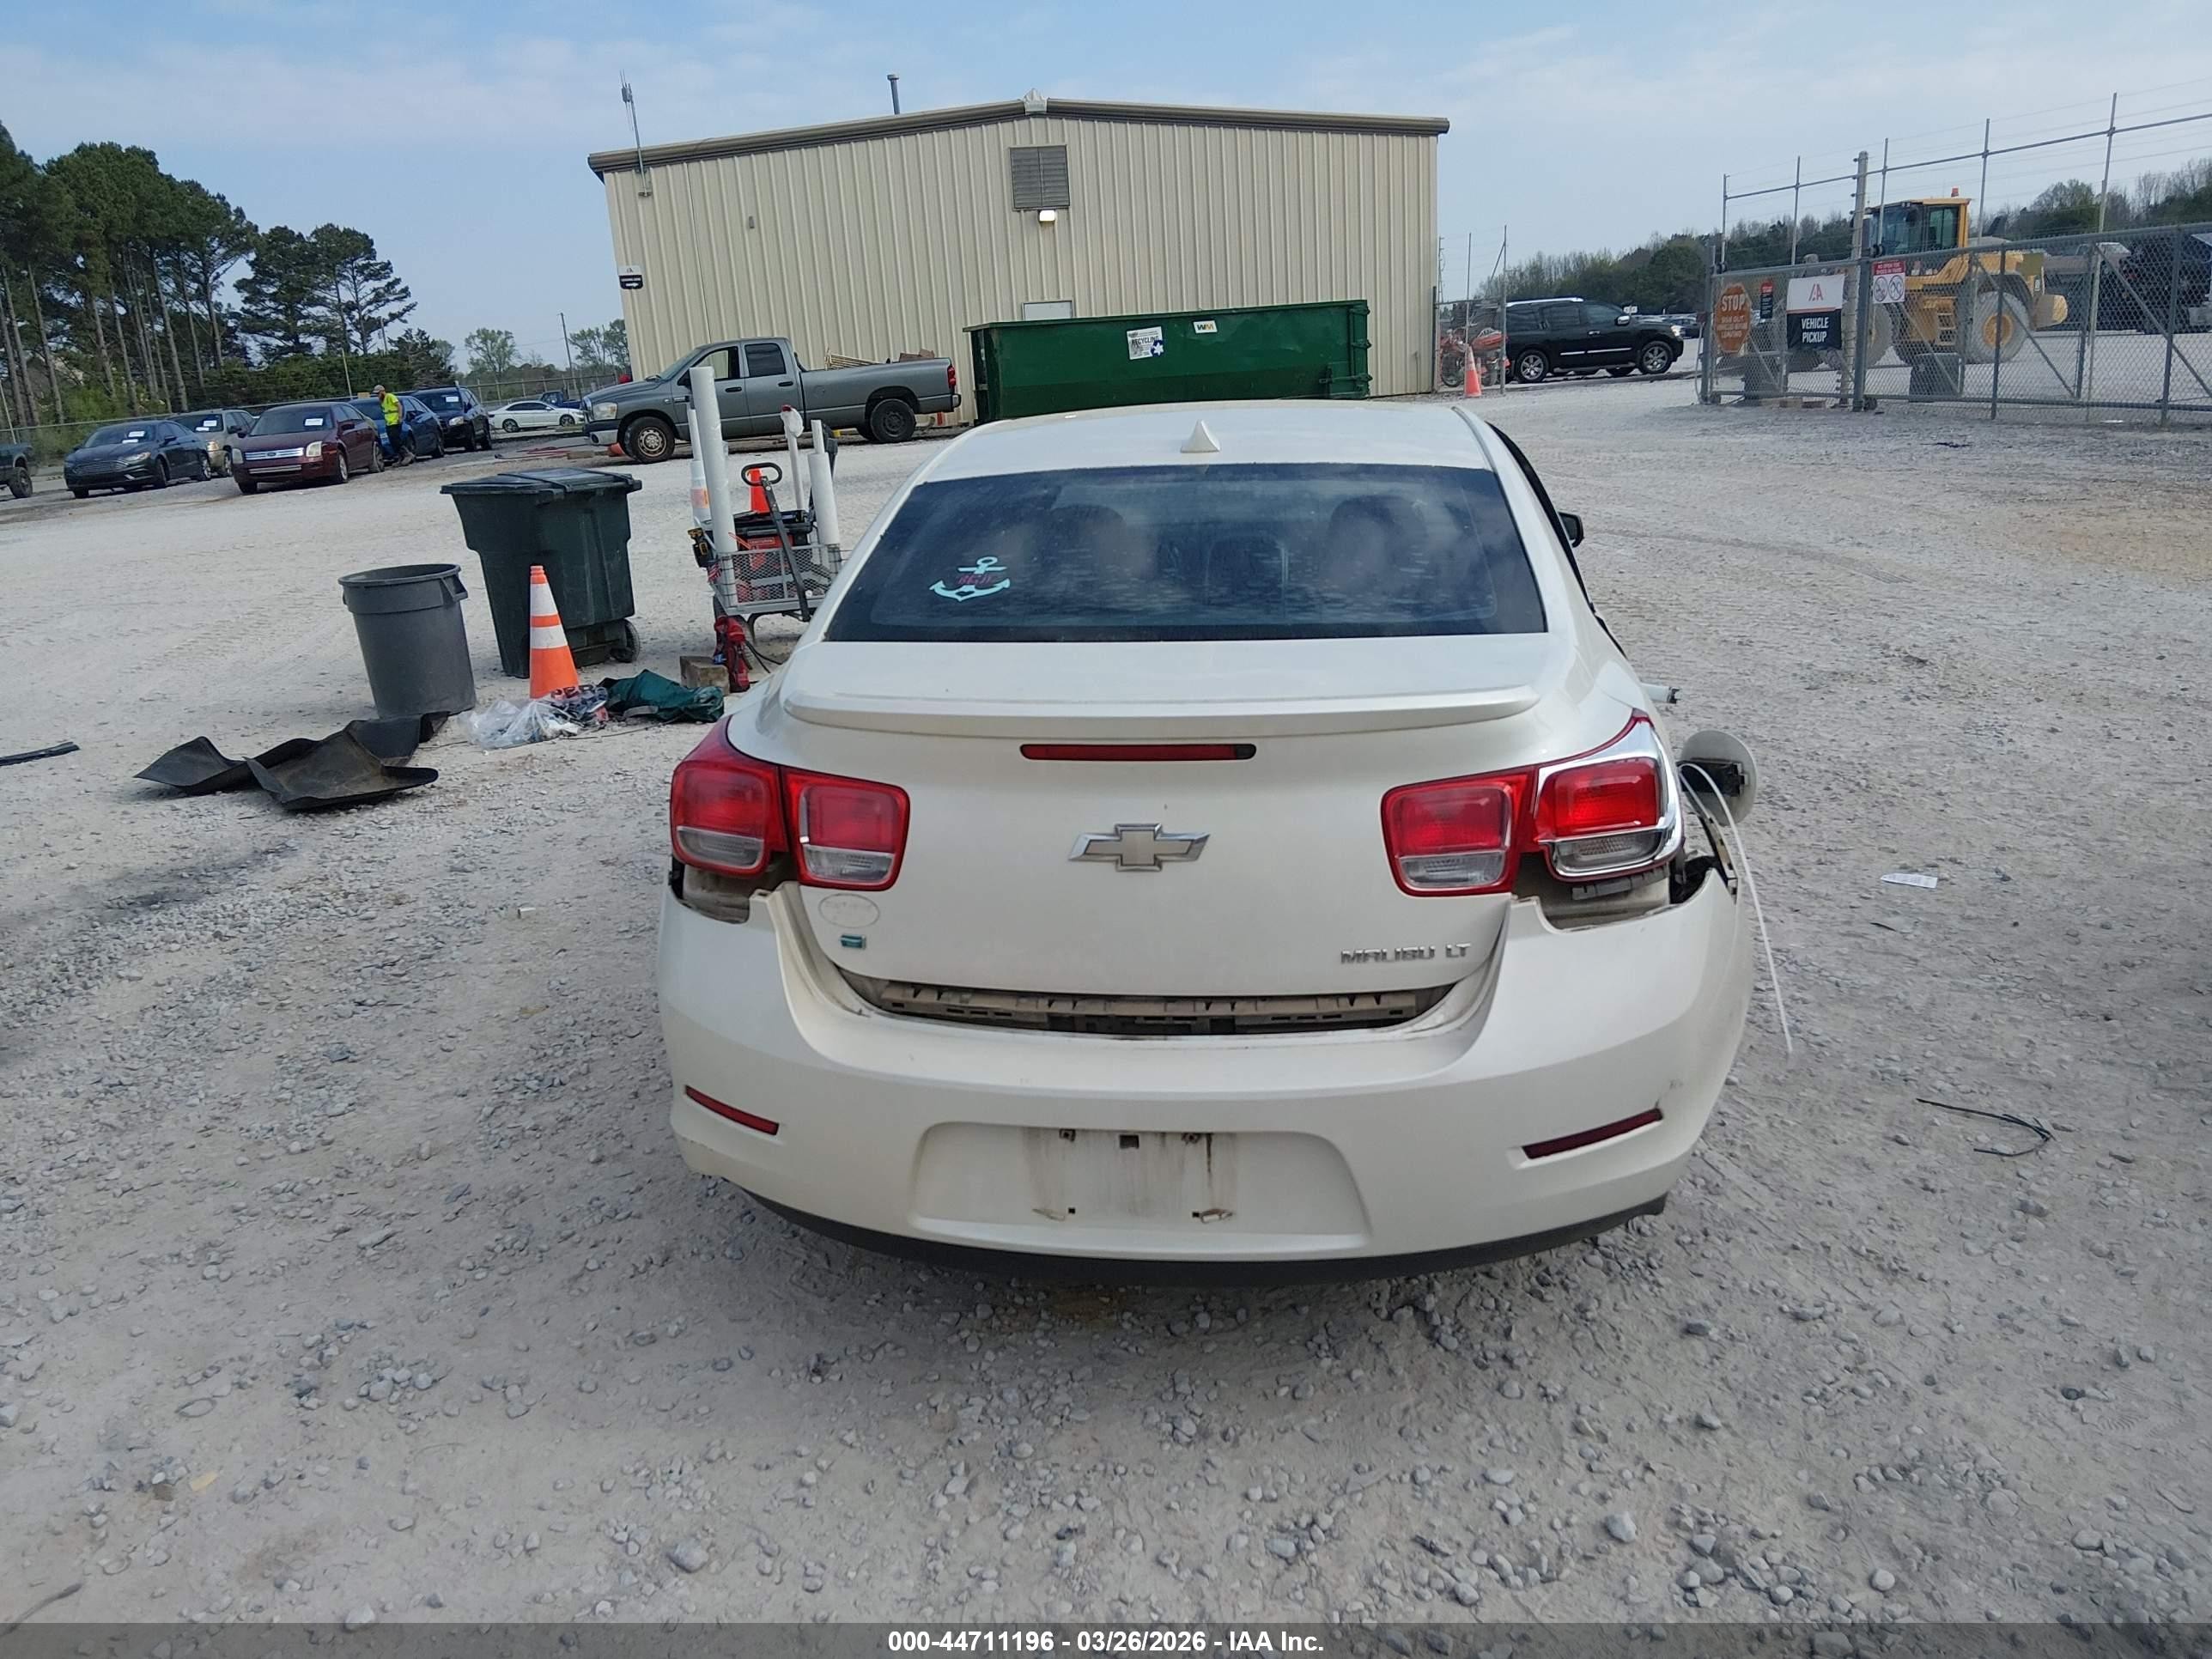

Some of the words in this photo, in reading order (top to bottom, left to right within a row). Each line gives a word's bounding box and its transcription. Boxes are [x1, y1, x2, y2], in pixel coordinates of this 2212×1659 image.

[1722, 294, 1745, 312] STOP
[1802, 317, 1829, 329] VEHICLE
[1802, 331, 1826, 343] PICKUP
[1340, 945, 1436, 964] MALIBU
[1445, 943, 1471, 958] LT
